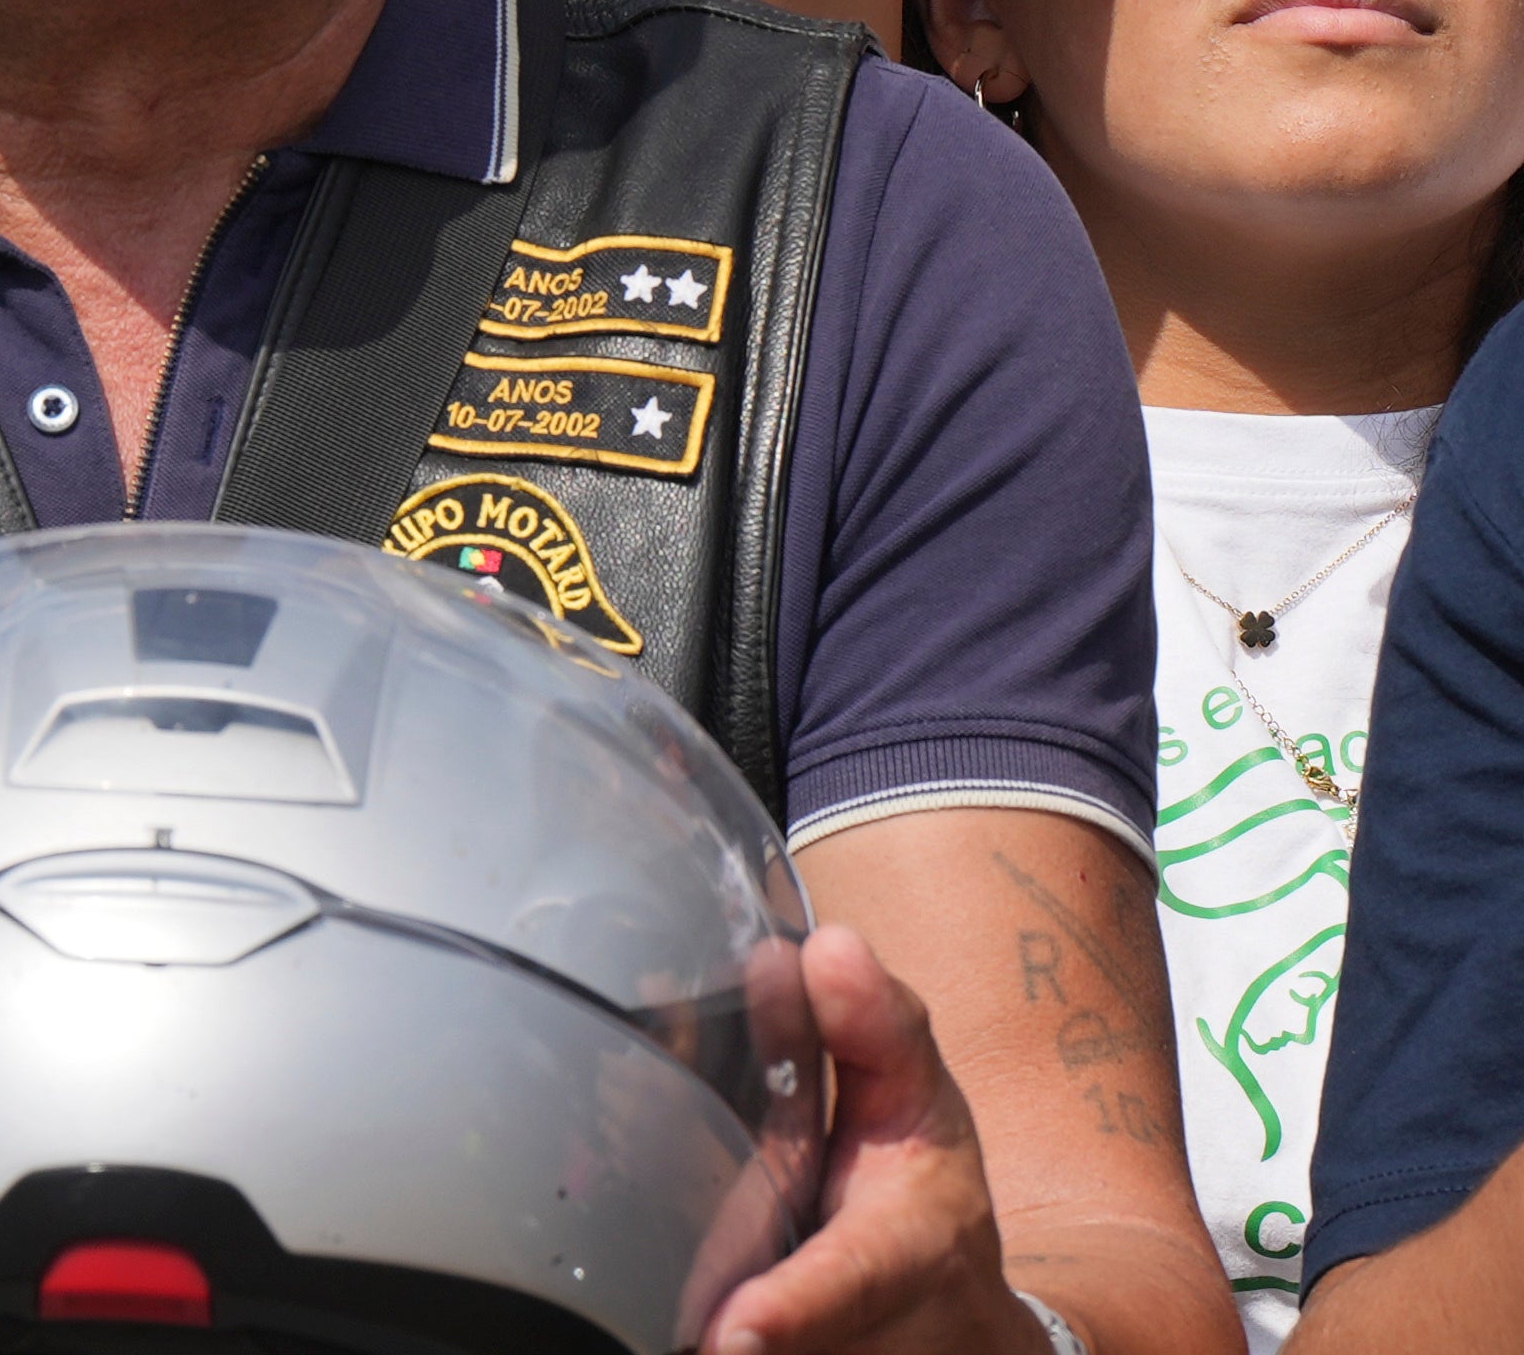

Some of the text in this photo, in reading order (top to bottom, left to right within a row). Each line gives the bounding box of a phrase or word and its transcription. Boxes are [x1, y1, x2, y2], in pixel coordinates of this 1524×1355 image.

[503, 266, 584, 295] ANOS
[486, 290, 609, 323] -07-2002
[487, 377, 574, 404] ANOS
[445, 400, 602, 439] 10-07-2002
[382, 493, 592, 611] UPO MOTARD
[1201, 685, 1244, 731] e
